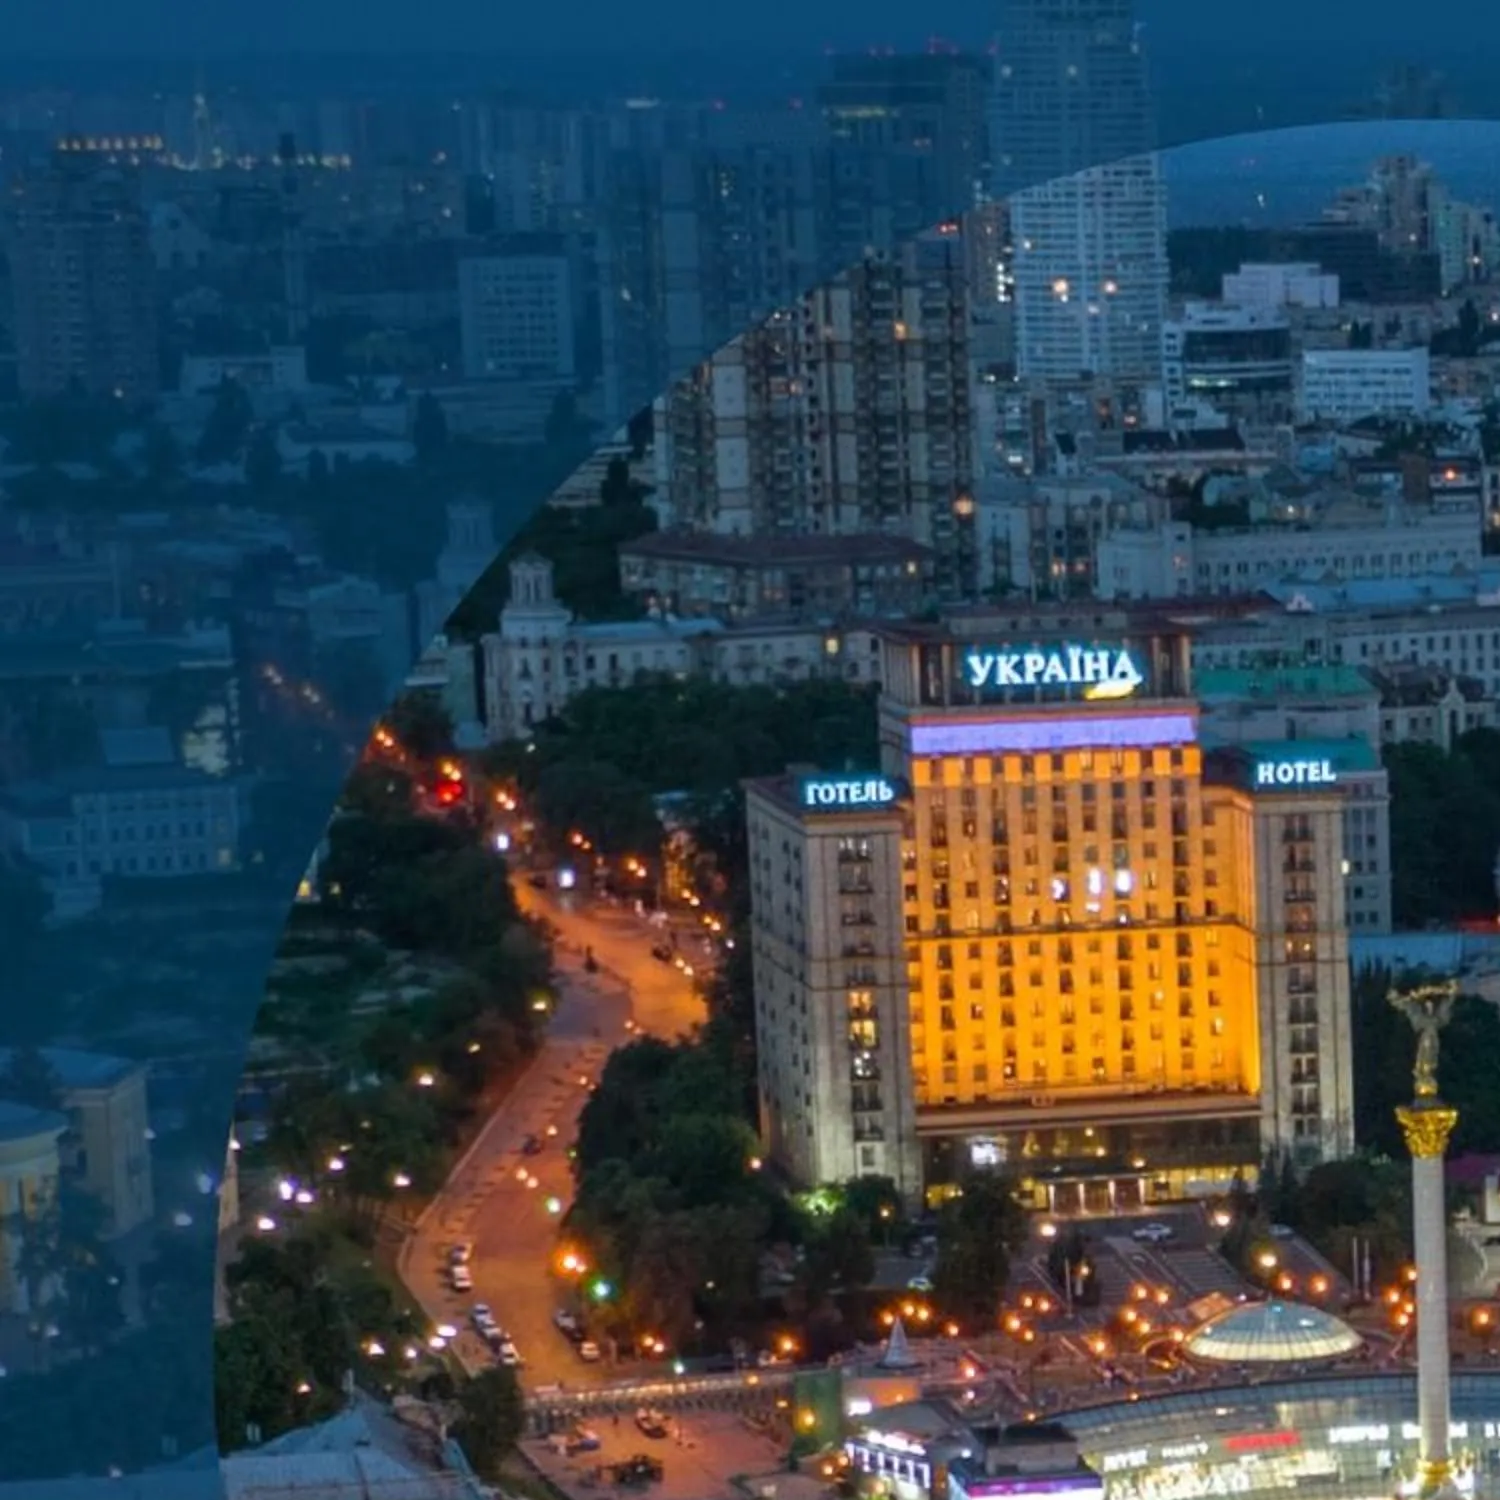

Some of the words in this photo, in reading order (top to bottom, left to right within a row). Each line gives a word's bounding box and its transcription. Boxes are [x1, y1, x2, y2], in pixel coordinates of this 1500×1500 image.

[968, 646, 1142, 687] УКРАЇНА
[1257, 760, 1337, 785] HOTEL
[806, 780, 894, 805] ГОТЕЛЬ
